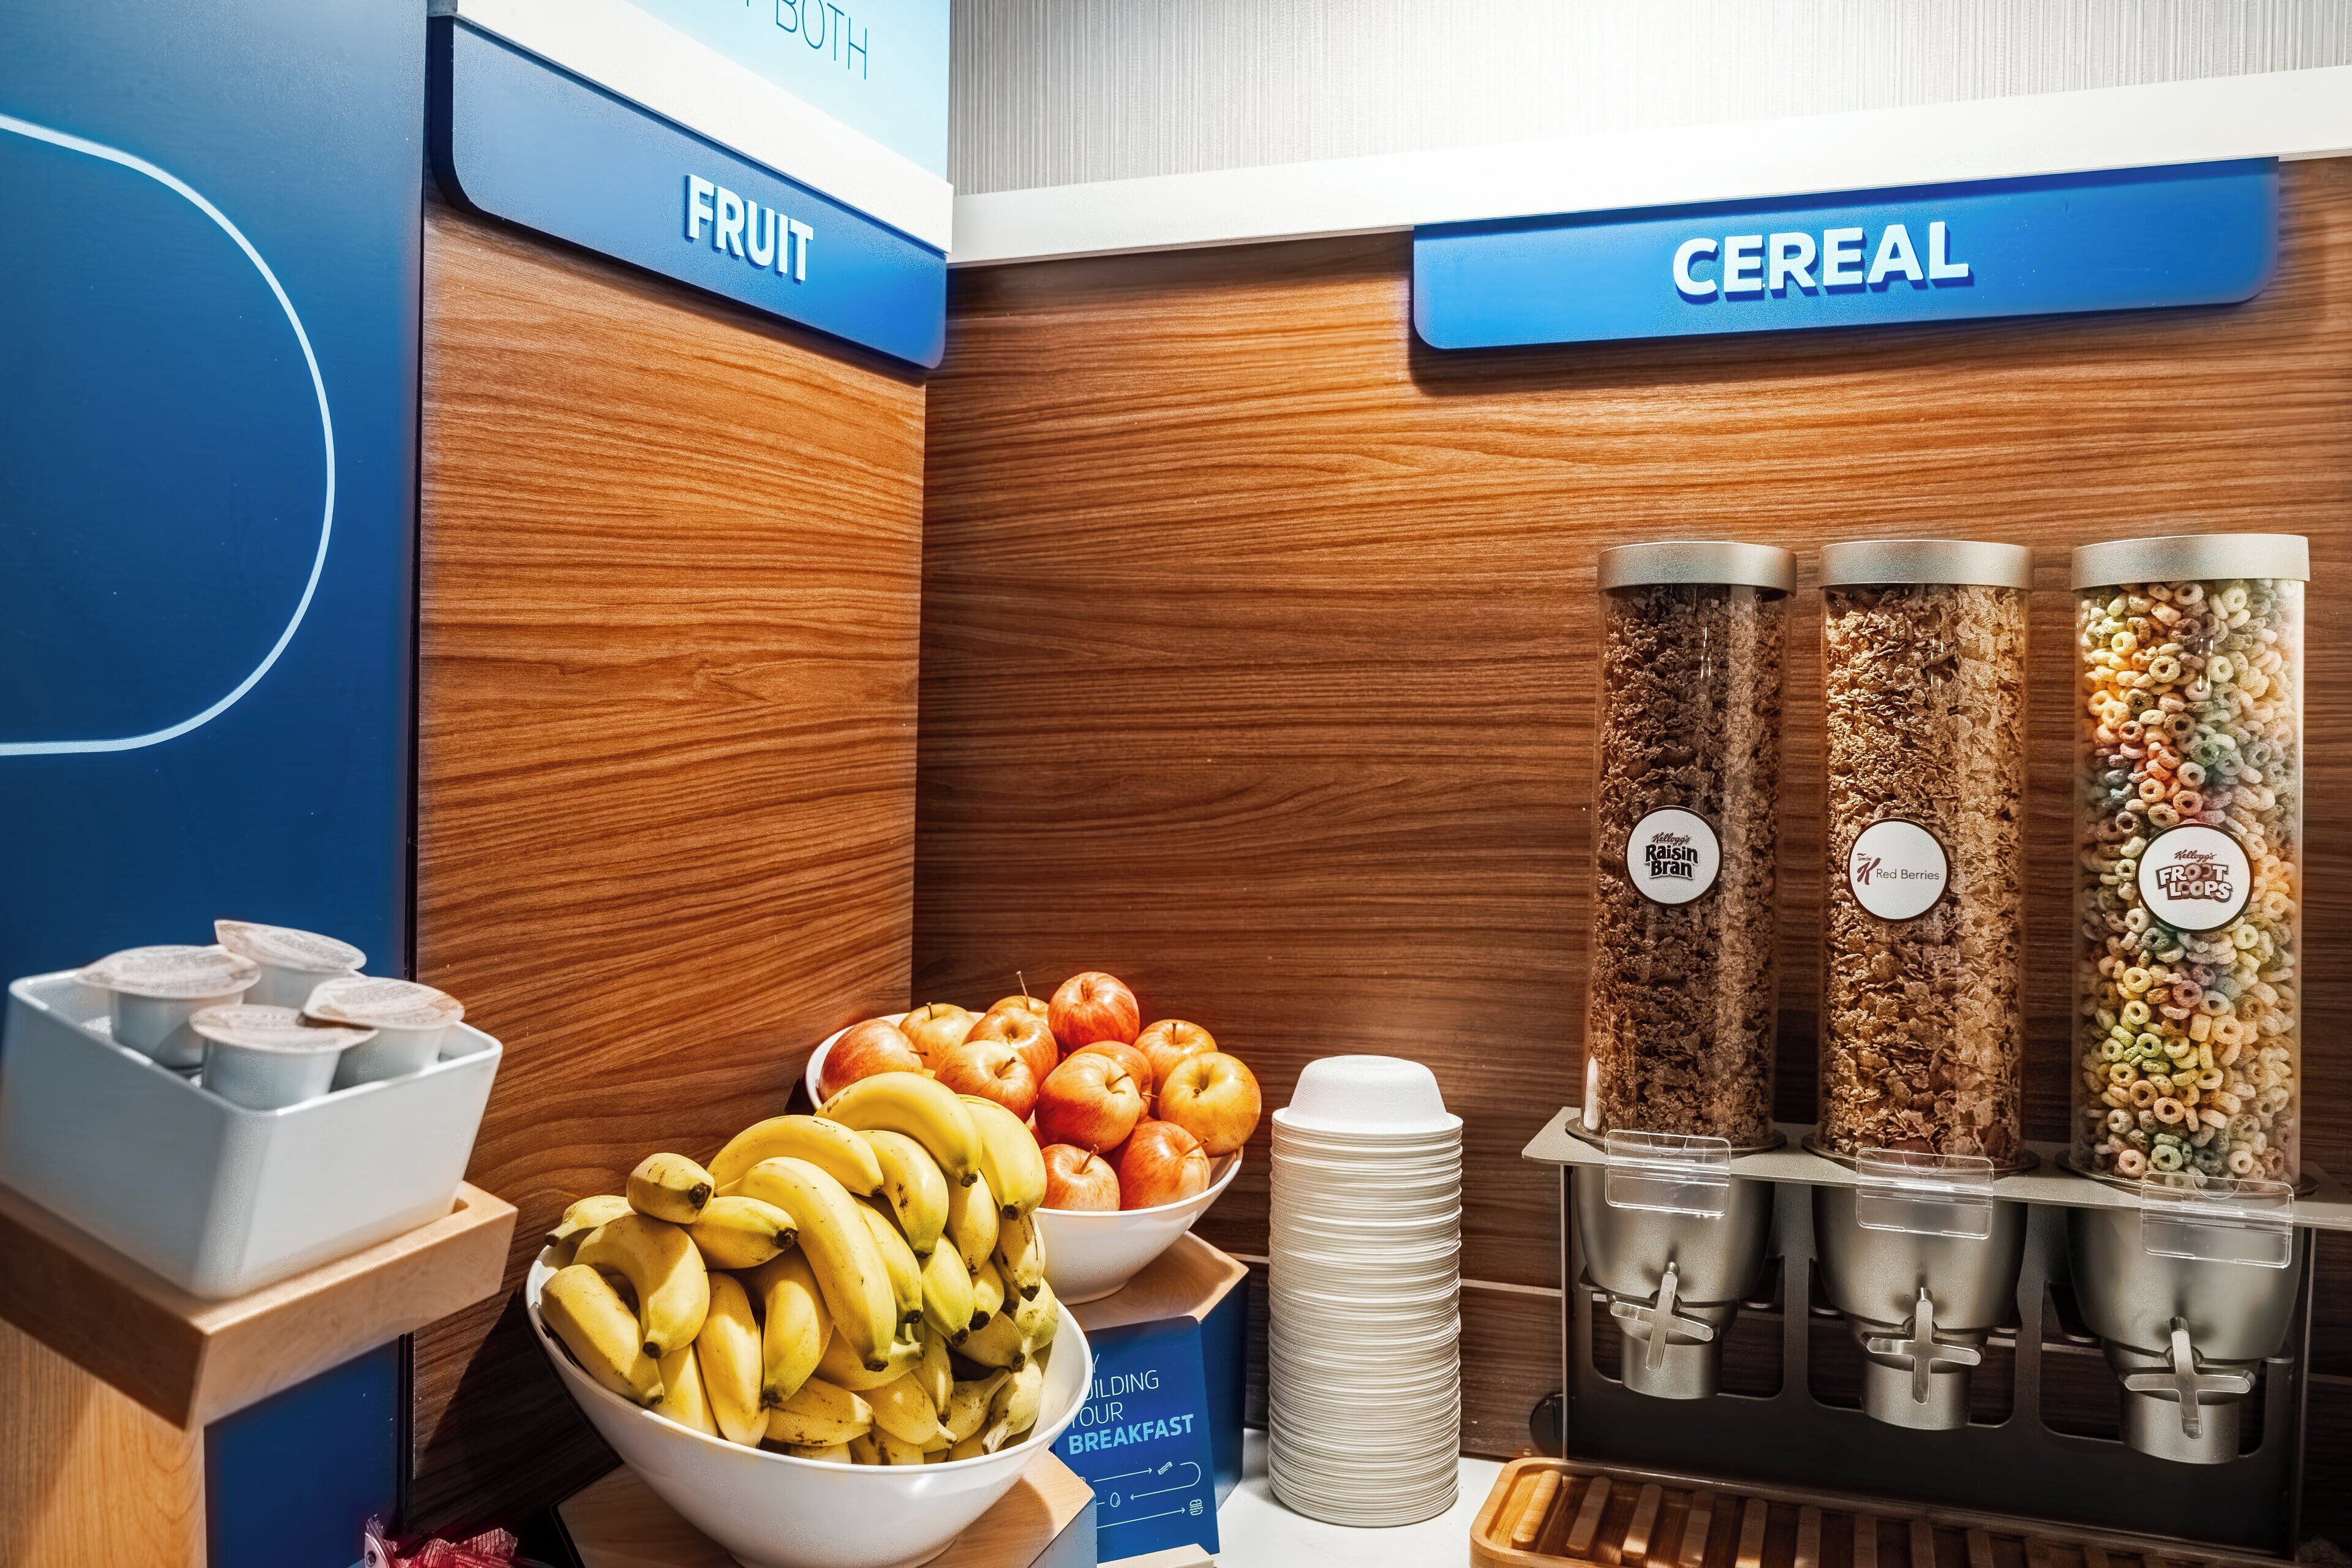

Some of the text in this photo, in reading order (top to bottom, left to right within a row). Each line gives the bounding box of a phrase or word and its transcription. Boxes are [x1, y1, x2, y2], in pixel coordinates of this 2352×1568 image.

[776, 0, 867, 80] BOTH
[686, 174, 814, 282] FRUIT
[1673, 221, 1969, 296] CEREAL
[1653, 832, 1691, 846] Kellogg's
[1645, 844, 1698, 864] Raisin
[2174, 849, 2217, 863] Kellogg's
[1651, 861, 1693, 878] Bran
[1856, 858, 1940, 885] K Red Berries
[2157, 863, 2228, 887] FROOT
[2168, 880, 2233, 900] LOOPS
[1086, 1370, 1159, 1401] UILDING
[1069, 1414, 1194, 1455] BREAKFAST
